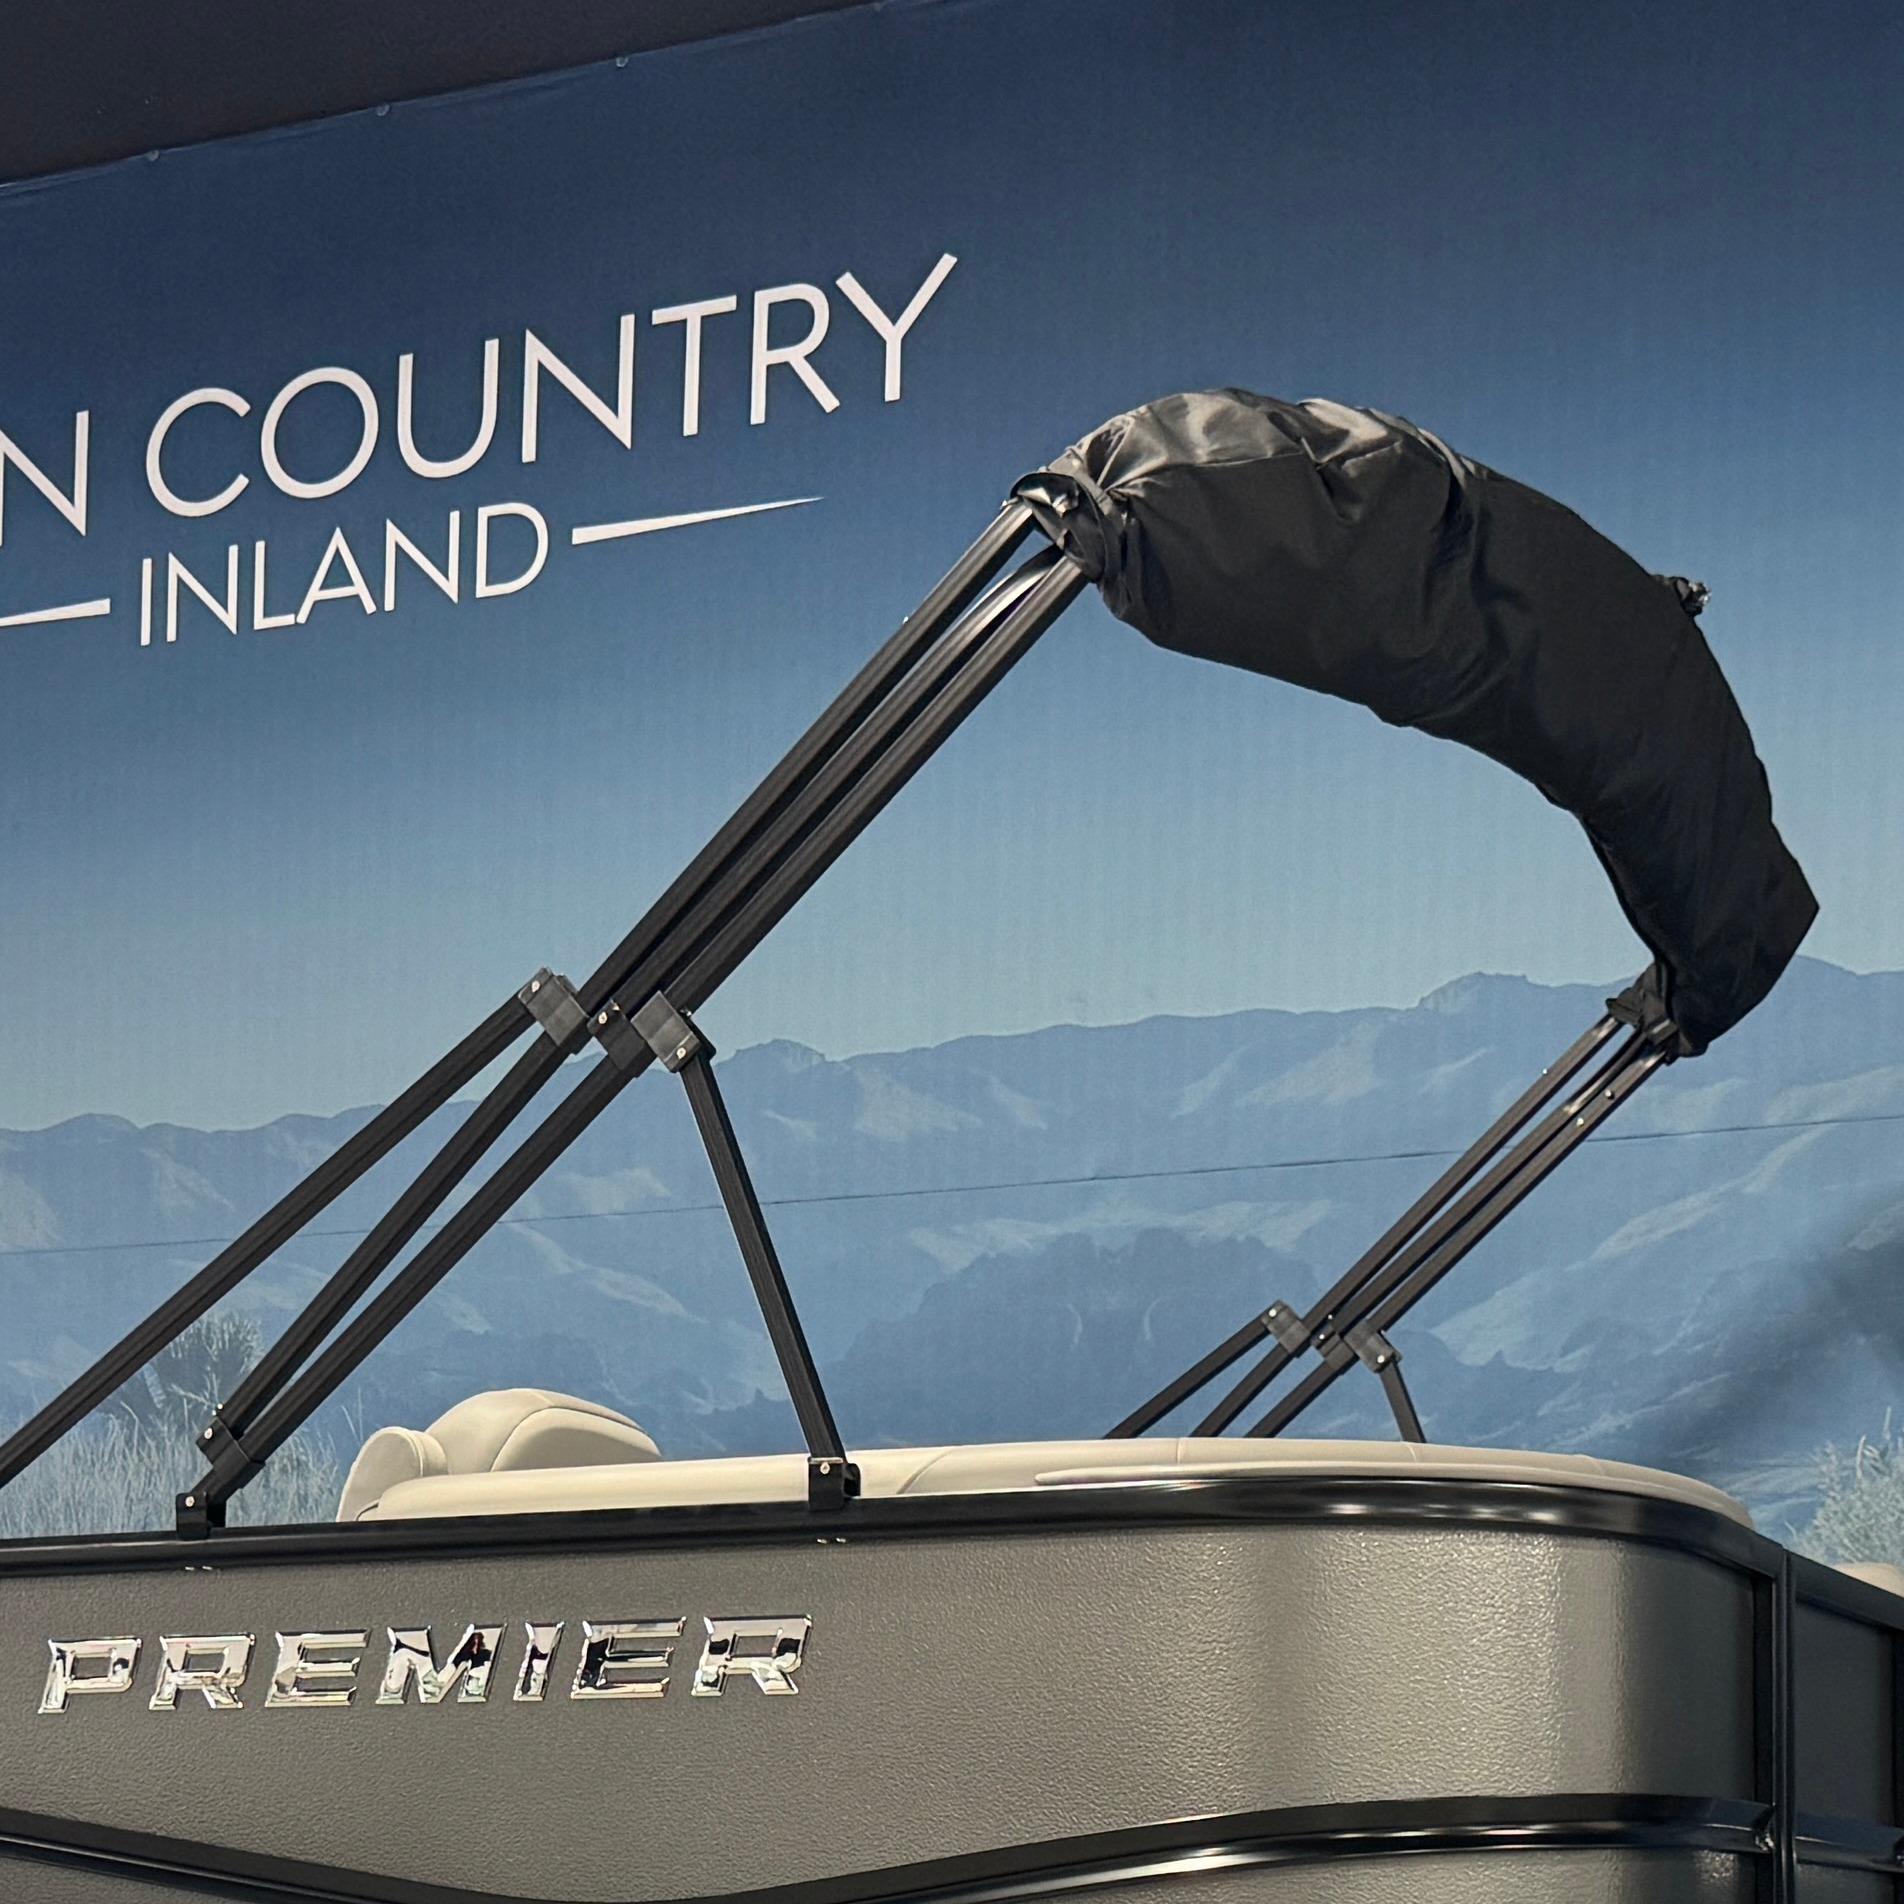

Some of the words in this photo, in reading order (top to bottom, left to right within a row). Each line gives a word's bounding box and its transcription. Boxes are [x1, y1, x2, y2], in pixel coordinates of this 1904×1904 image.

[145, 252, 959, 518] COUNTRY
[139, 501, 550, 647] INLAND
[36, 1613, 814, 1715] PREMIER
